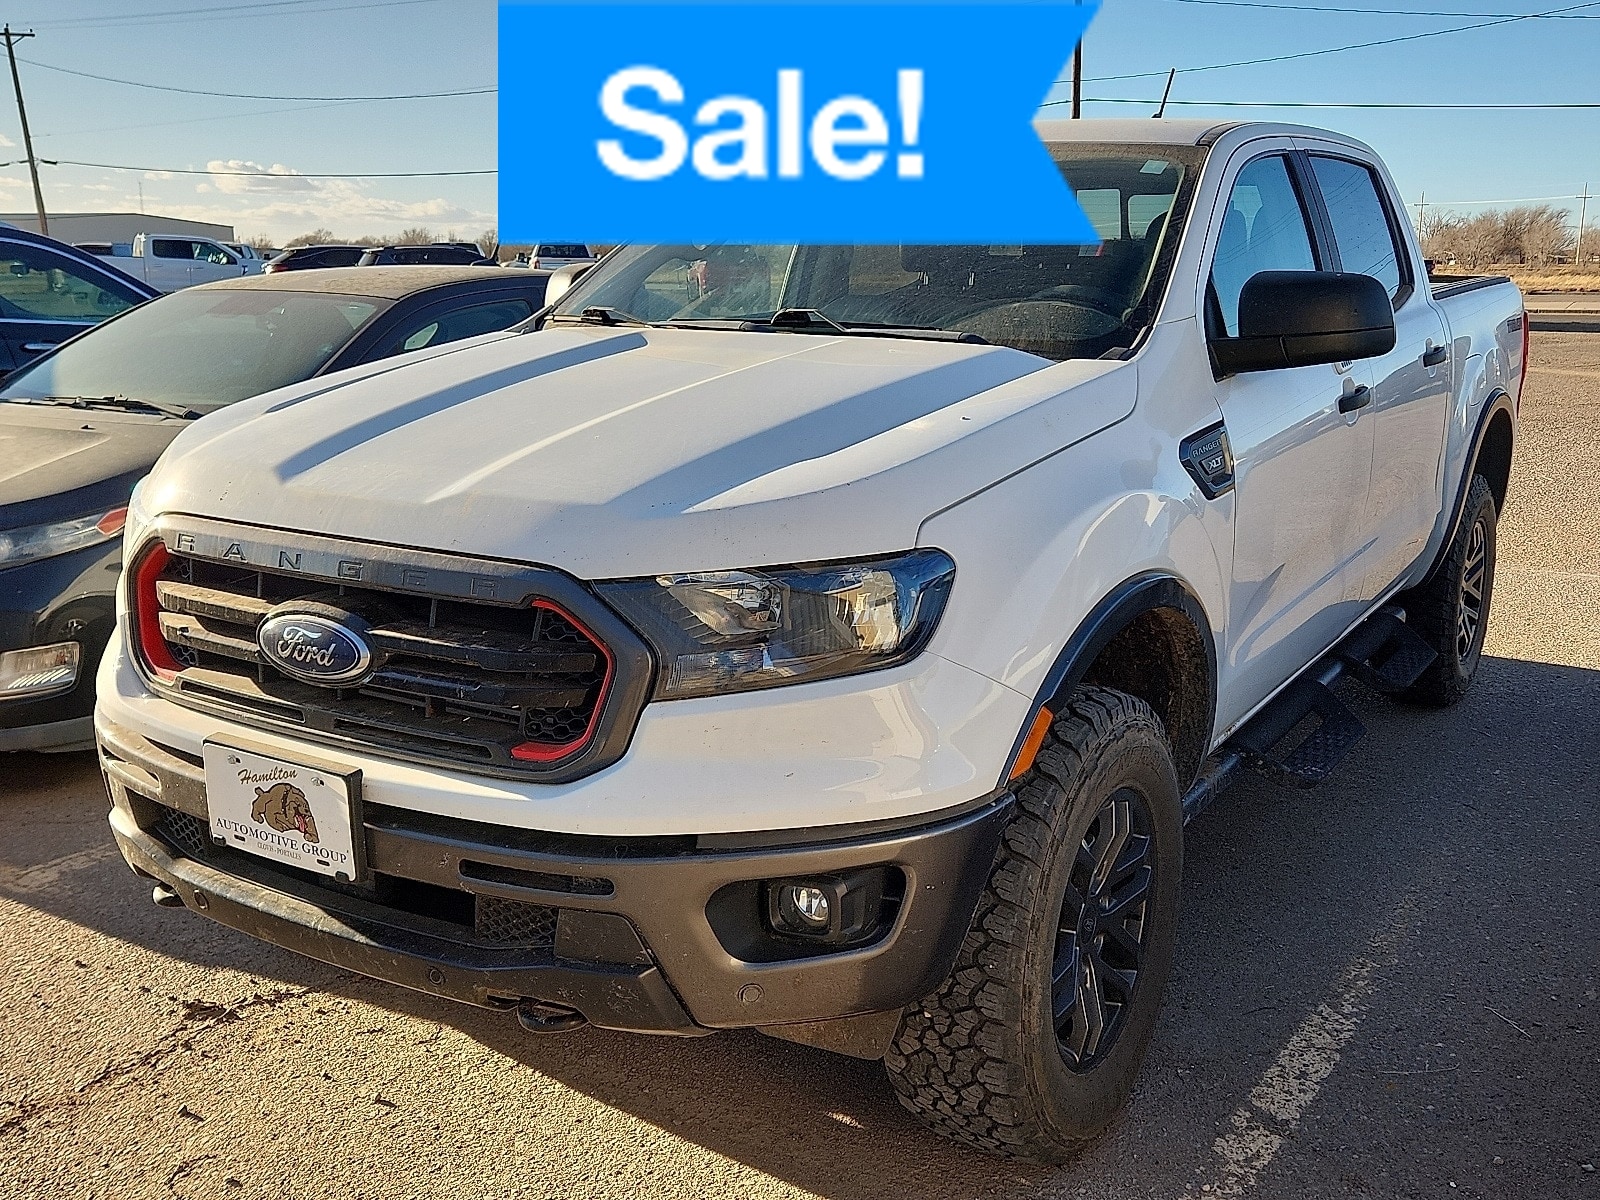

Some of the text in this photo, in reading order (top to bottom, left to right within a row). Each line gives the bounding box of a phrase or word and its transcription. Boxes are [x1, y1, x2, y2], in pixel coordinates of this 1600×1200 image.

[1192, 439, 1222, 458] RANGER
[1207, 455, 1223, 471] XLT
[176, 532, 499, 598] RANGER
[276, 626, 335, 668] Ford
[237, 766, 298, 785] Hamilton
[216, 817, 347, 864] AUTOMOTIVE GROUP
